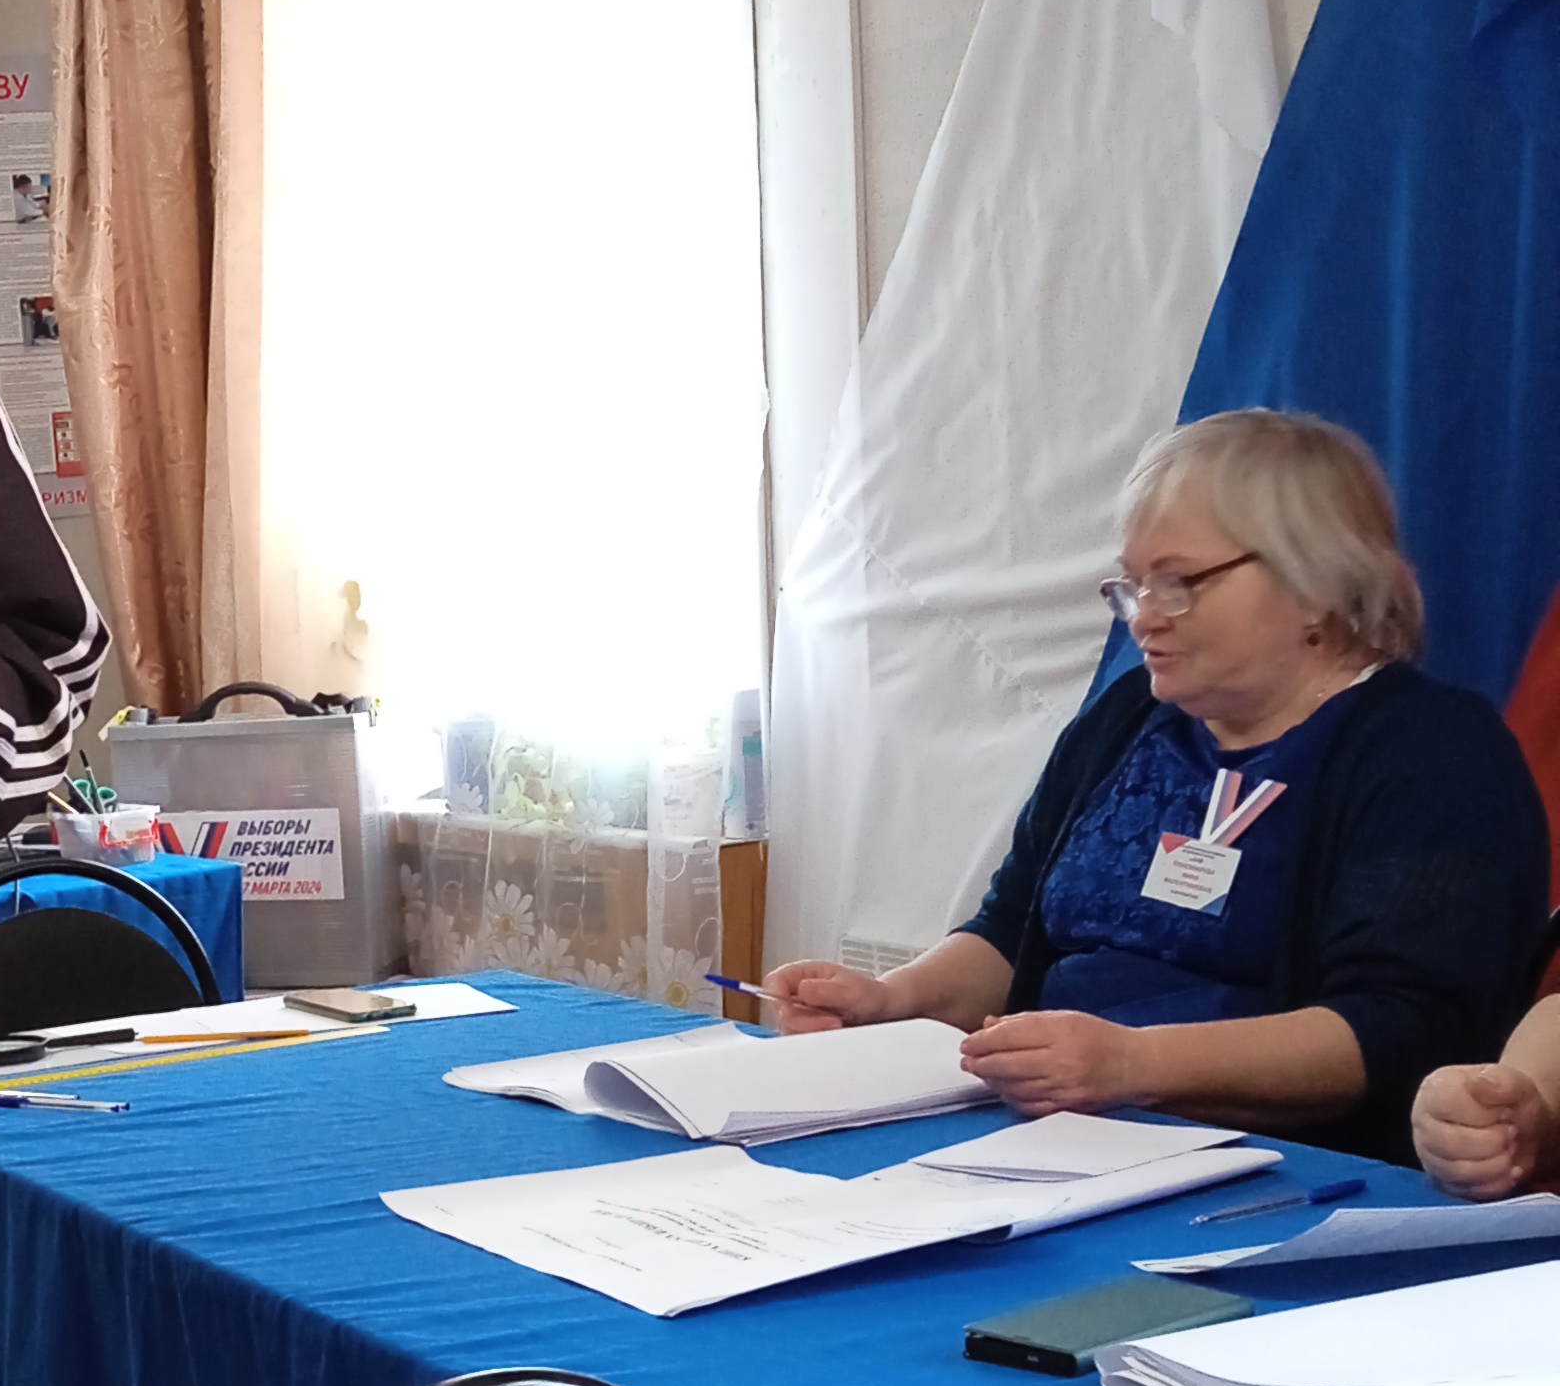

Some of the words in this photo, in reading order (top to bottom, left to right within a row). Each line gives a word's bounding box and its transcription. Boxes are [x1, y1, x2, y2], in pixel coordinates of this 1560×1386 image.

[42, 491, 87, 505] РИЗМ
[237, 818, 312, 836] ВЫБОРЫ
[229, 839, 335, 858] ПРЕЗИДЕНТА
[246, 861, 291, 878] ССИИ
[251, 881, 291, 895] МАРТА
[293, 880, 323, 895] 2024
